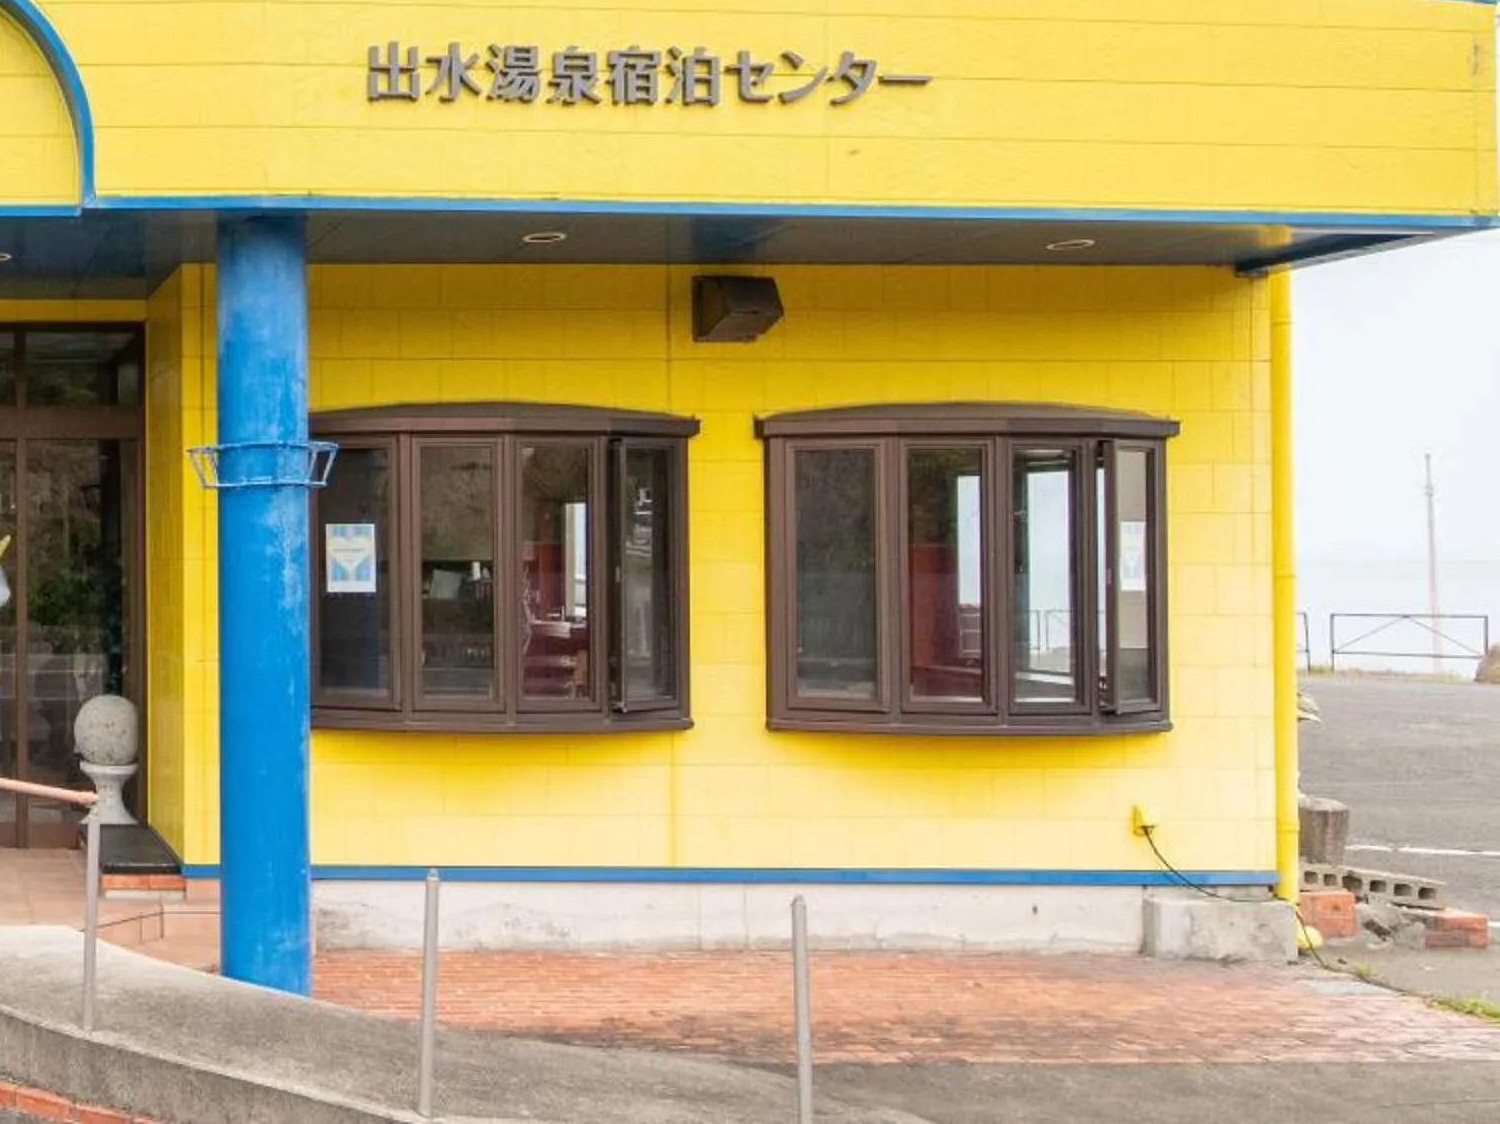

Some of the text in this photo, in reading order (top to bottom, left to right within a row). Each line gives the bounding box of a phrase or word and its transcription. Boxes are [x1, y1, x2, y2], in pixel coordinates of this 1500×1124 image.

[367, 41, 932, 106] 出水湯泉宿泊センター
